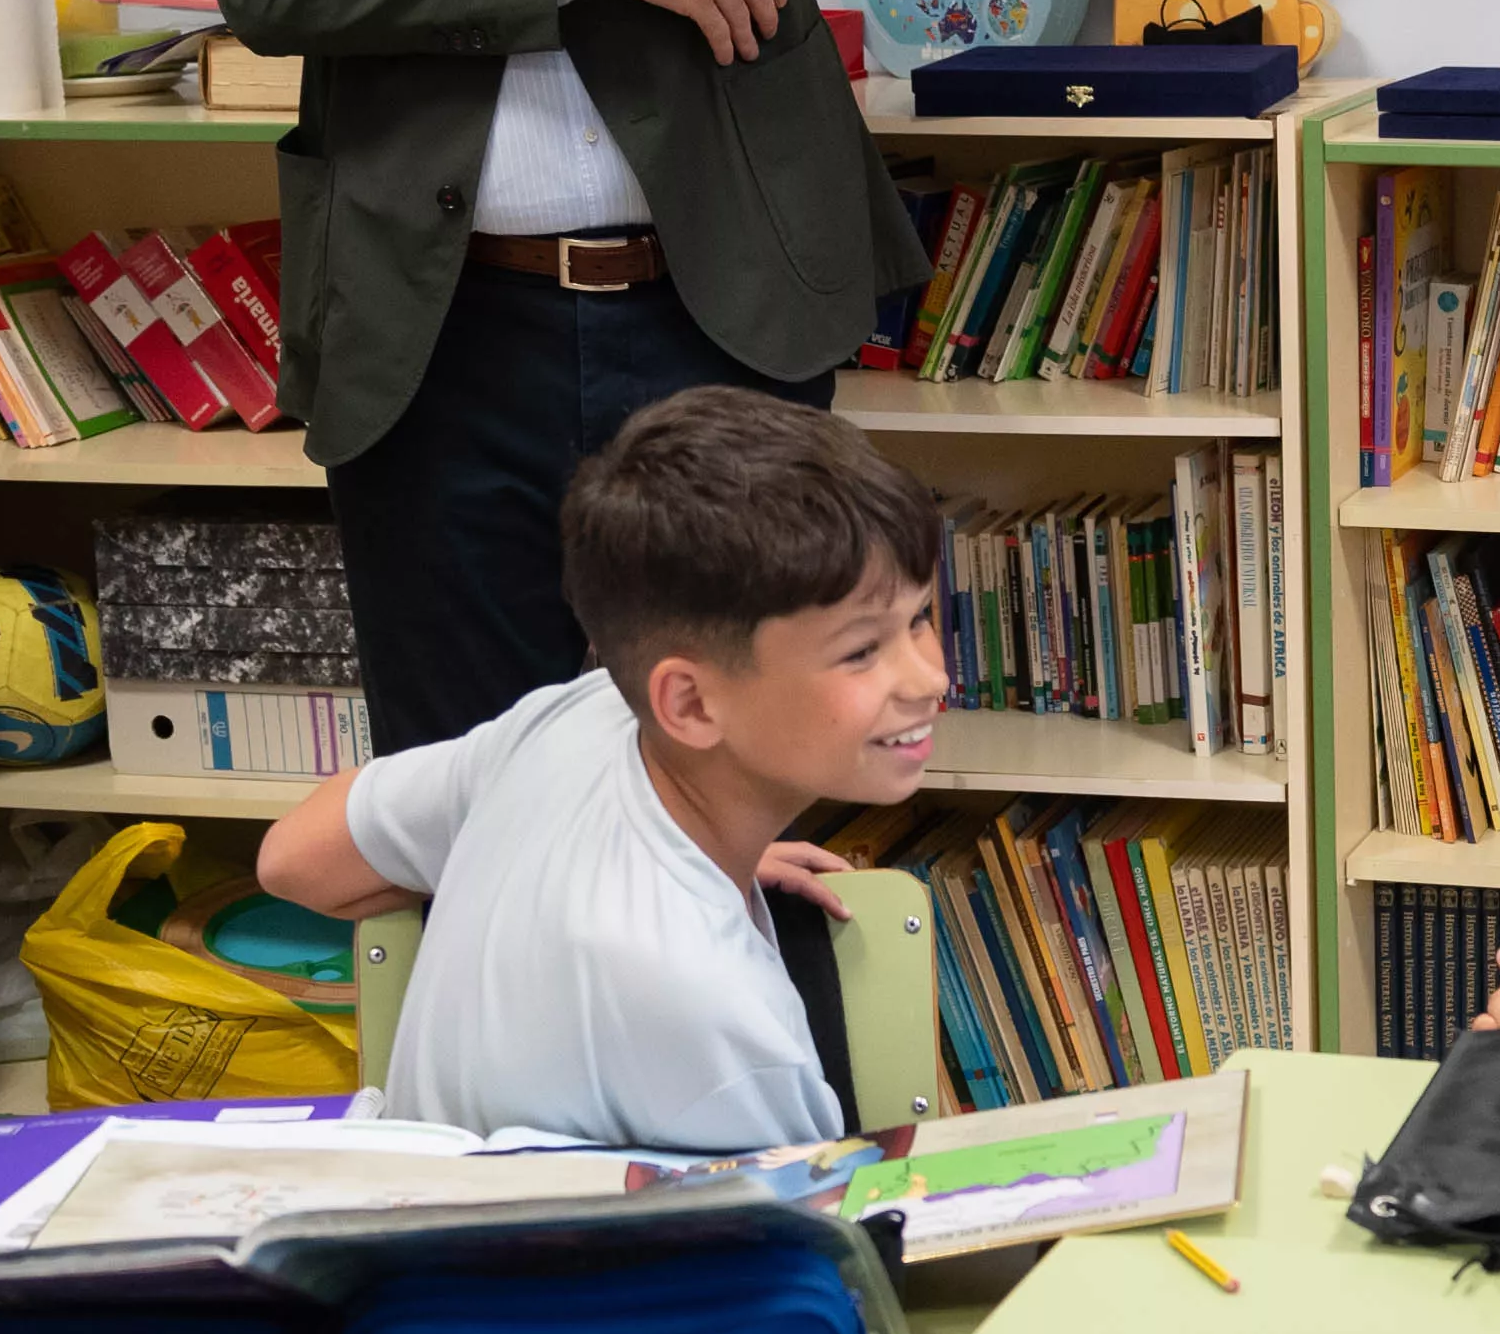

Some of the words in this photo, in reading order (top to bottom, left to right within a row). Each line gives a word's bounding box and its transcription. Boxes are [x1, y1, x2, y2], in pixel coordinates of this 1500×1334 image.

[939, 192, 970, 274] ACTUAL
[1060, 309, 1073, 326] La
[1072, 243, 1098, 294] misteriosa
[1361, 270, 1370, 301] INCA
[1361, 311, 1371, 338] ORO
[1239, 486, 1254, 510] ATLAS
[1268, 477, 1279, 488] el
[1269, 490, 1280, 522] LEON
[1271, 536, 1281, 552] los
[1271, 554, 1284, 608] animales
[1274, 609, 1284, 624] de
[1273, 629, 1286, 678] AFRICA
[1133, 865, 1147, 897] MEDIO
[1141, 898, 1154, 927] CINCA
[1178, 894, 1196, 936] LLAMA
[1192, 897, 1207, 932] TIGRE
[1213, 893, 1228, 933] PERRO
[1232, 896, 1250, 949] BALLENA
[1271, 897, 1285, 941] CIERVO
[1148, 930, 1159, 947] DEL
[1189, 945, 1201, 962] los
[1201, 942, 1213, 959] los
[1221, 944, 1233, 961] los
[1257, 943, 1267, 958] los
[1379, 912, 1391, 958] HISTORIA
[1403, 911, 1414, 958] HISTORIA
[1424, 912, 1435, 958] HISTORIA
[1444, 914, 1455, 959] HISTORIA
[1466, 914, 1476, 960] HISTORIA
[1486, 915, 1497, 961] HISTORIA
[1153, 949, 1171, 994] NATURAL
[1243, 962, 1255, 979] los
[1276, 952, 1288, 969] los
[1085, 965, 1105, 1003] SECUESTRO
[1192, 961, 1211, 1010] animales
[1205, 960, 1224, 1011] animales
[1224, 961, 1242, 1011] animales
[1259, 959, 1273, 1004] animales
[1278, 970, 1294, 1021] animales
[1381, 960, 1391, 1012] UNIVERSAL
[1404, 959, 1414, 1011] UNIVERSAL
[1425, 960, 1435, 1012] UNIVERSAL
[1445, 961, 1456, 1014] UNIVERSAL
[1466, 962, 1476, 1013] UNIVERSAL
[1165, 996, 1182, 1041] ENTORNO
[1202, 1009, 1214, 1024] de
[1216, 1012, 1228, 1027] de
[1246, 978, 1263, 1028] animales
[1265, 1005, 1275, 1018] de
[1176, 1042, 1185, 1054] EL
[1284, 1023, 1293, 1038] de
[1381, 1014, 1392, 1049] SALVAT
[1404, 1013, 1414, 1047] SALVAT
[1425, 1015, 1435, 1048] SALVAT
